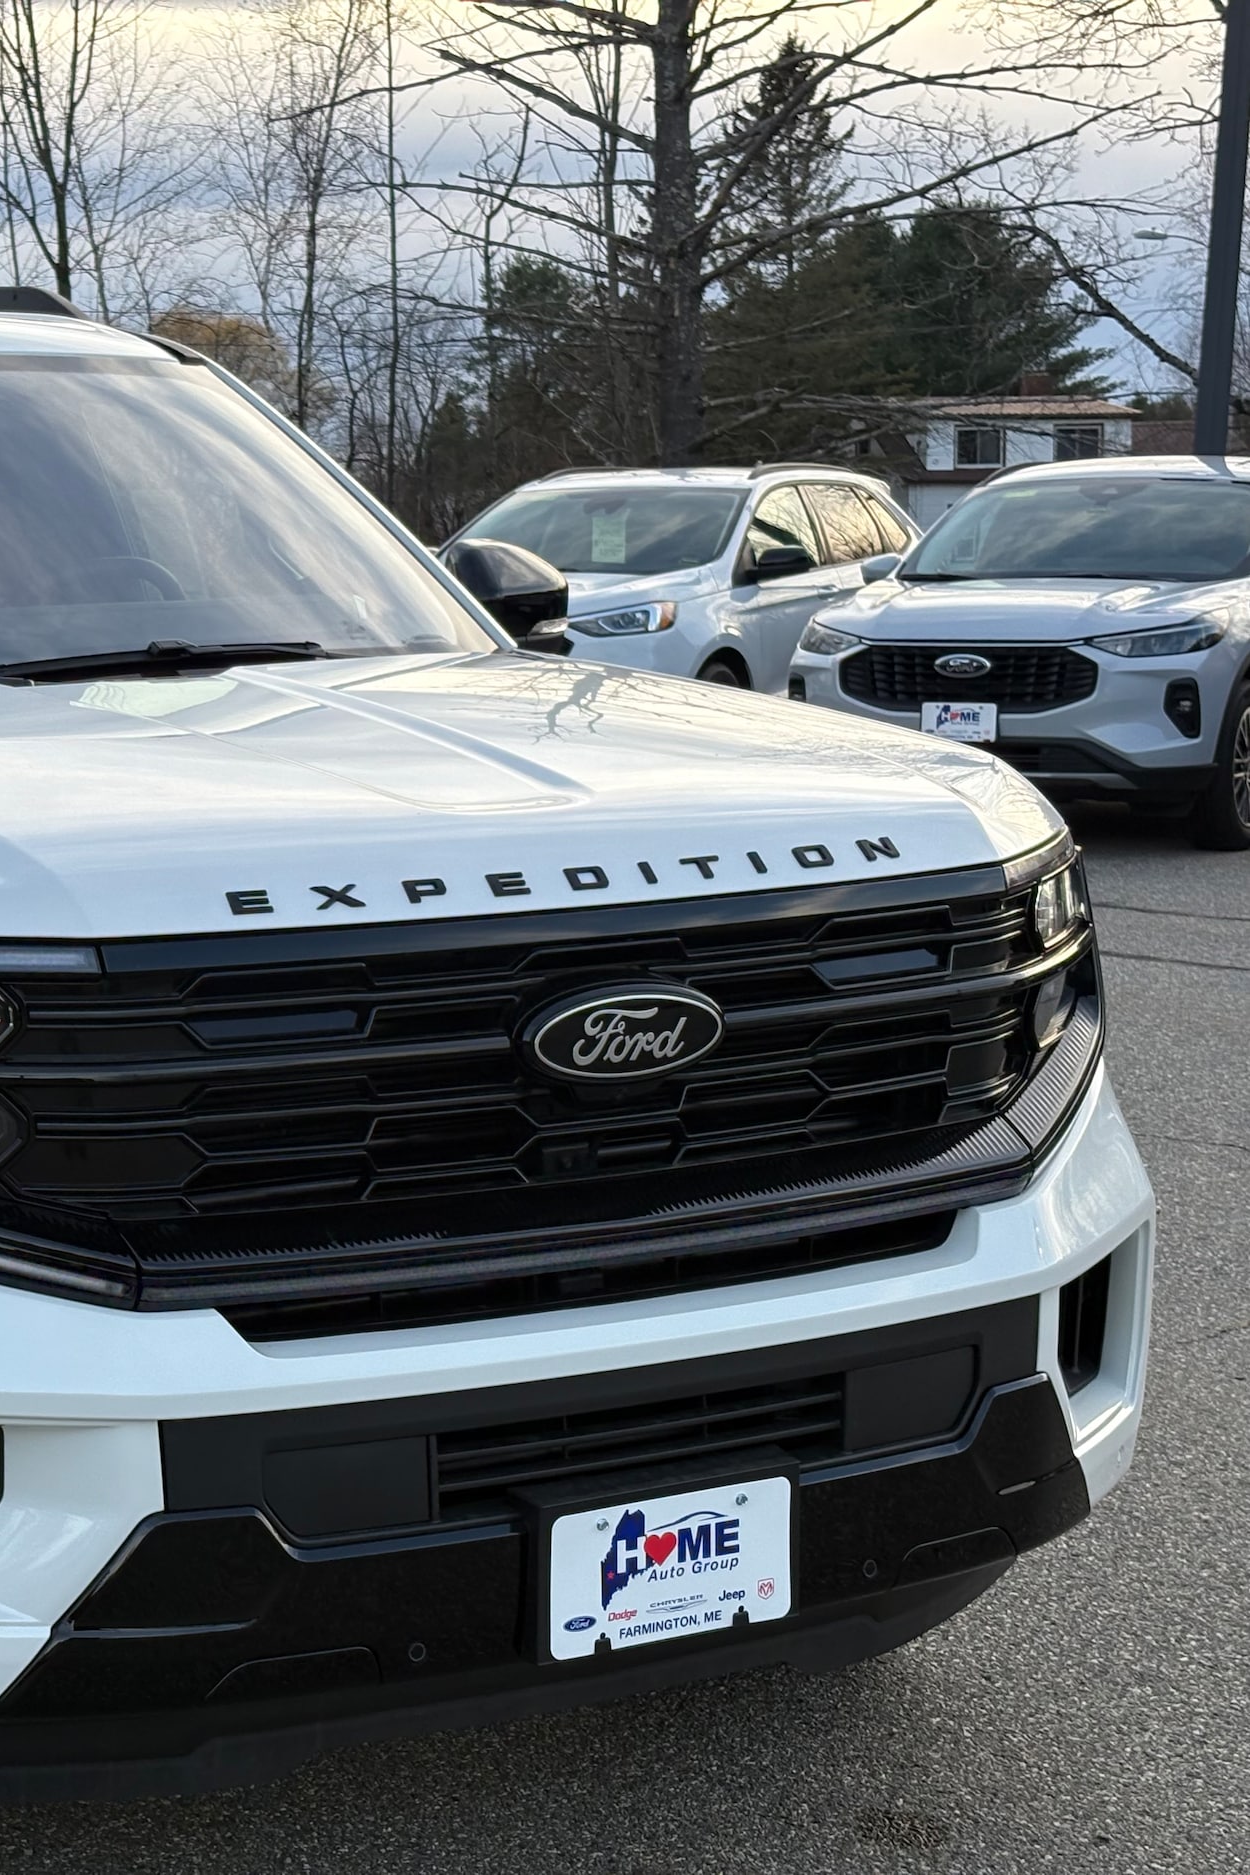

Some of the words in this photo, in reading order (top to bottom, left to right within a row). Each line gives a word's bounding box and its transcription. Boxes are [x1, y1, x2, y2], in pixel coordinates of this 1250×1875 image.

[225, 836, 901, 916] EXPEDITION
[573, 1005, 688, 1067] Ford
[647, 1566, 685, 1583] Auto
[691, 1557, 739, 1573] Group
[649, 1594, 704, 1608] CHRYSLER
[718, 1589, 746, 1601] Jeep
[569, 1618, 591, 1630] Ford
[607, 1609, 638, 1621] Dodge
[619, 1614, 701, 1639] FARMINGTON,
[706, 1610, 723, 1623] ME
